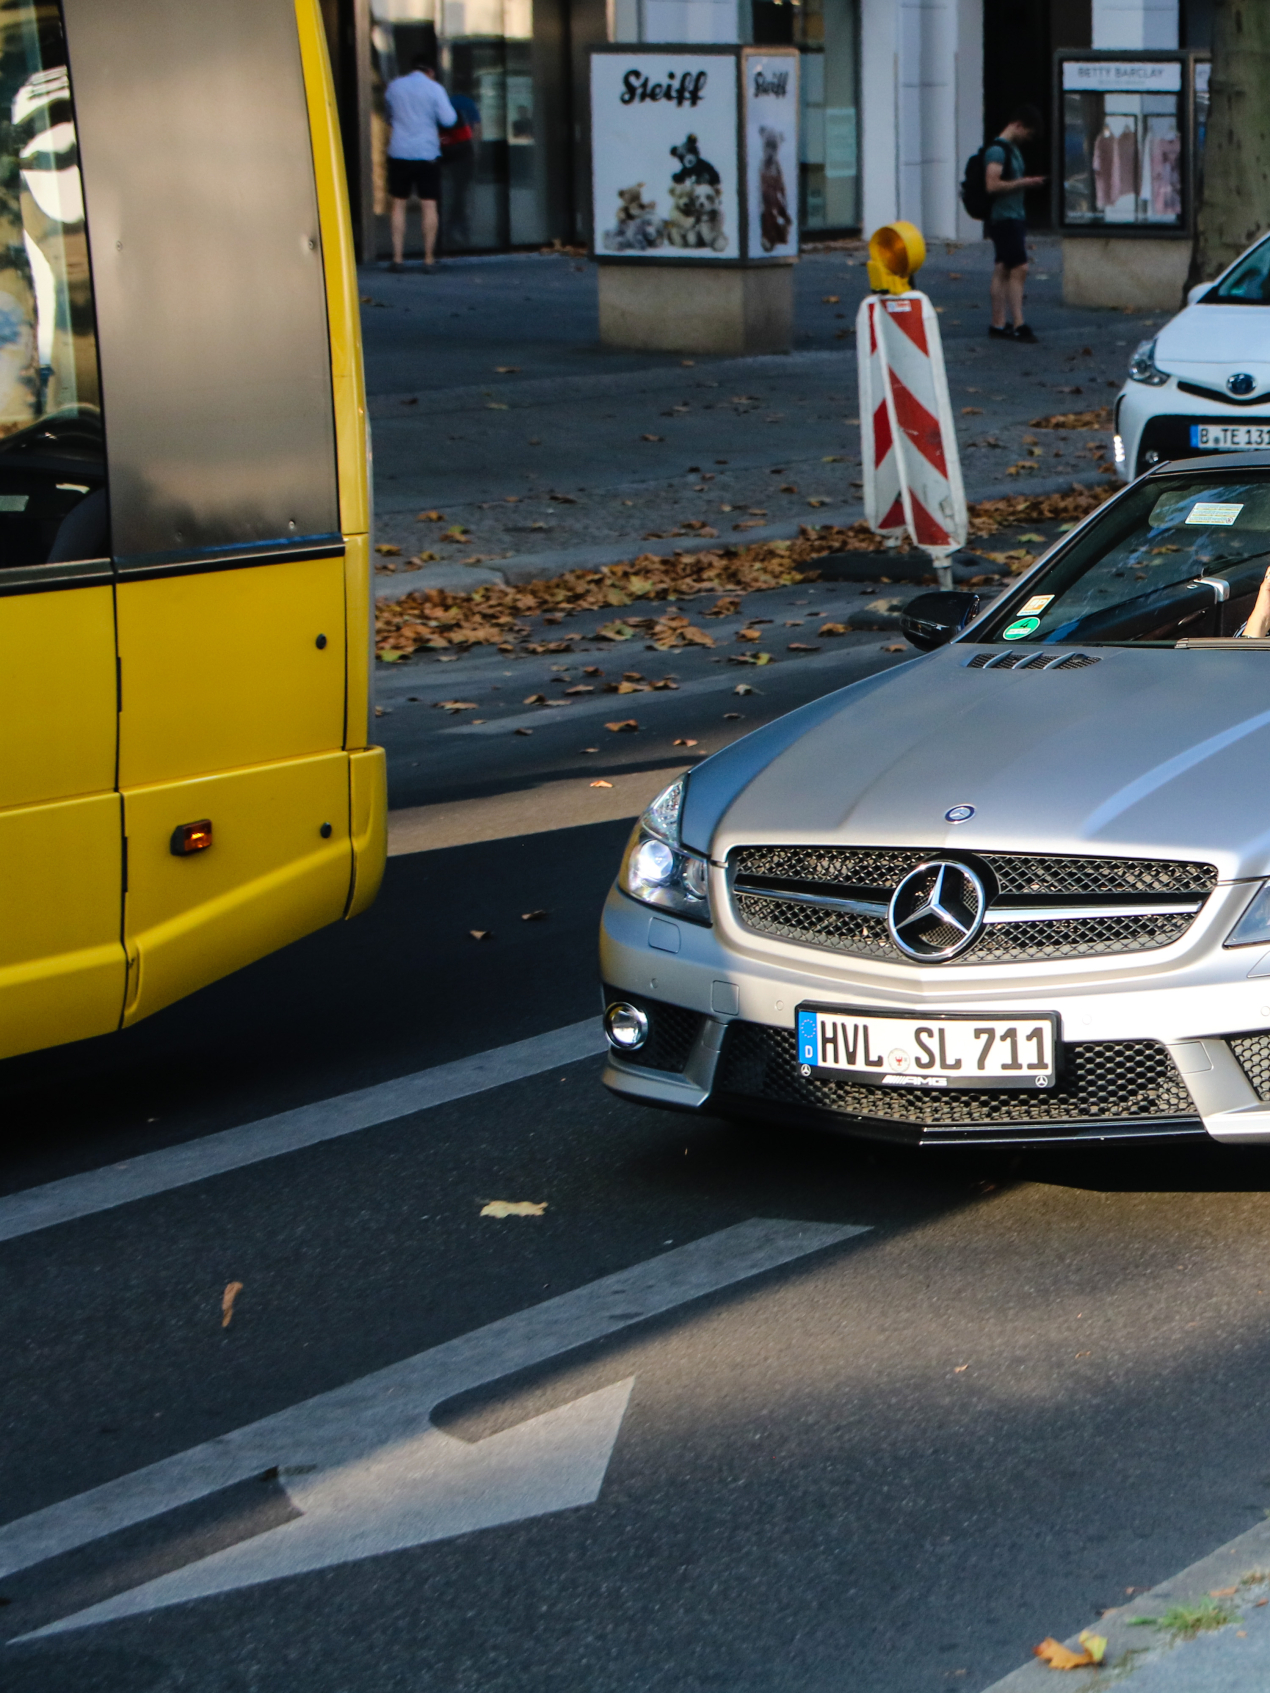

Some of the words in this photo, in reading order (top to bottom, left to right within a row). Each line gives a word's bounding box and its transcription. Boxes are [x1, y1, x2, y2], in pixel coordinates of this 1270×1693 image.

[1077, 67, 1110, 79] BETTY
[1114, 67, 1164, 79] BARCLAY
[620, 69, 708, 108] Steiff
[1200, 428, 1209, 445] B
[1221, 428, 1240, 445] TE
[804, 1045, 814, 1058] D
[820, 1020, 883, 1068] HVL
[914, 1027, 962, 1071] SL
[974, 1027, 1049, 1071] 711
[900, 1077, 948, 1087] AMG
